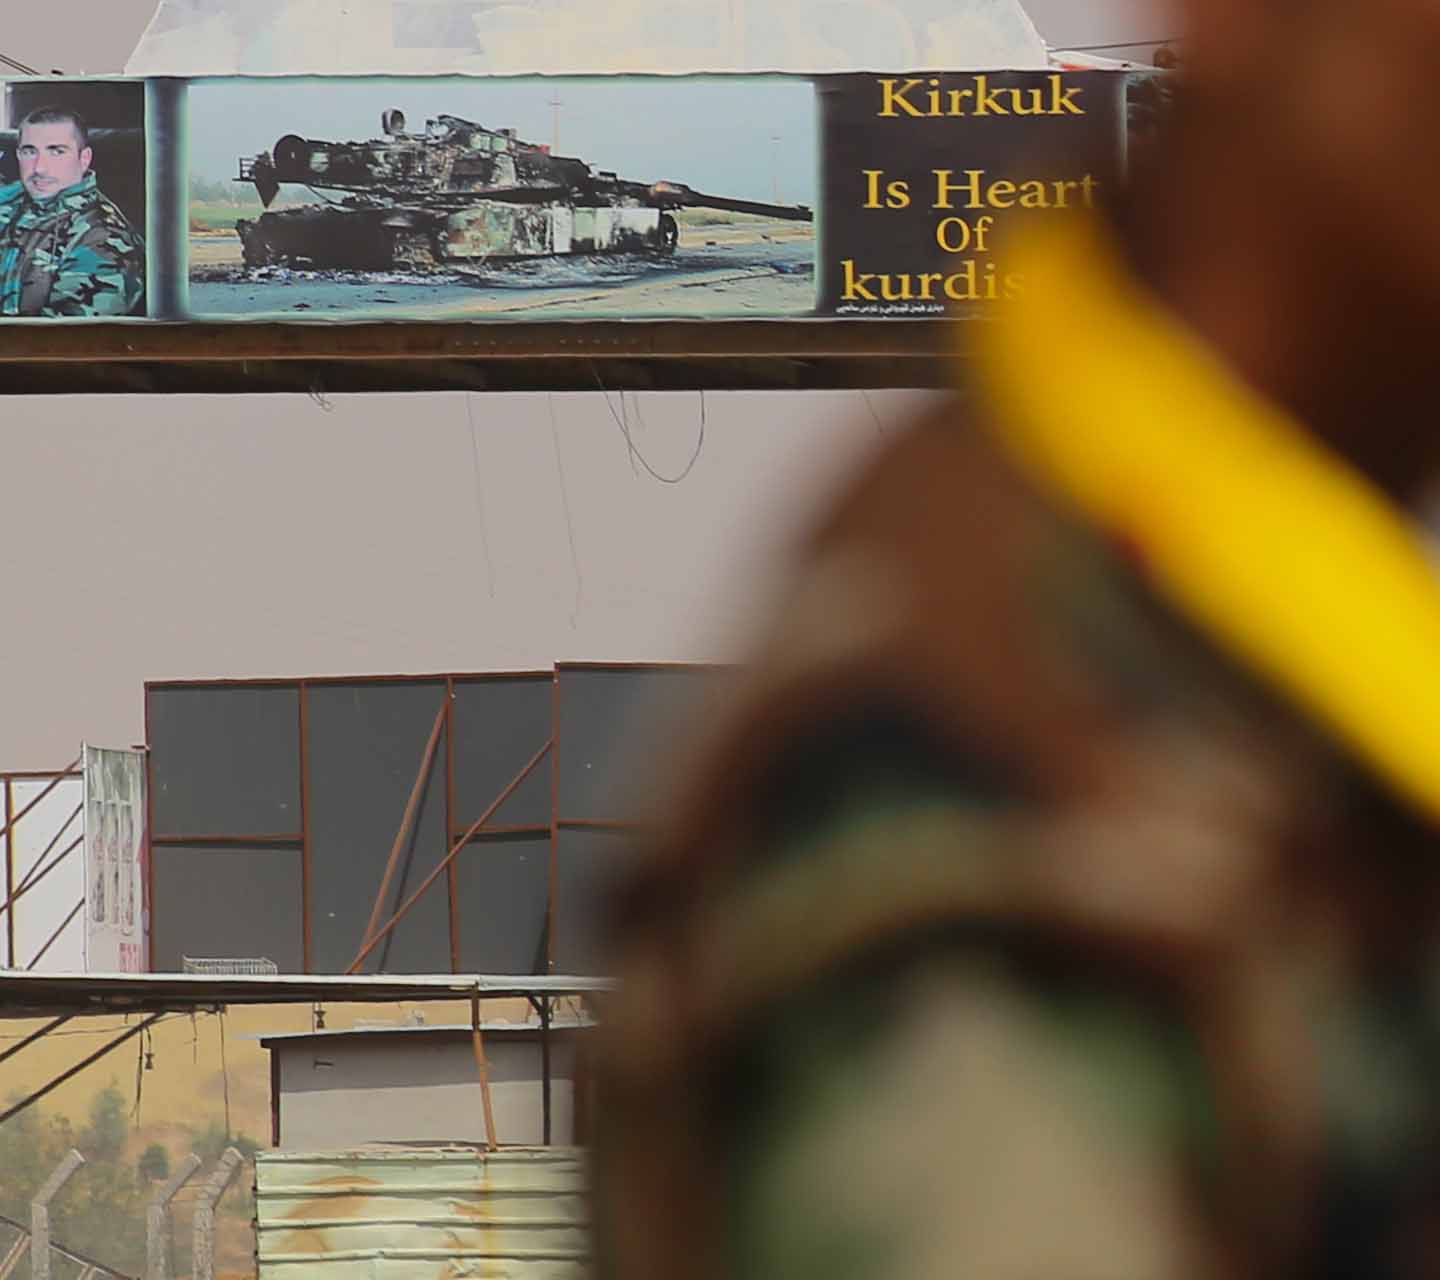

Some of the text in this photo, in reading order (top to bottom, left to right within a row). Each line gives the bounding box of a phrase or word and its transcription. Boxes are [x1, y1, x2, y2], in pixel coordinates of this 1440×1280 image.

[877, 75, 1086, 117] Kirkuk
[862, 170, 1100, 209] Is Heart
[936, 216, 994, 253] Of
[840, 259, 1025, 301] kurdis
